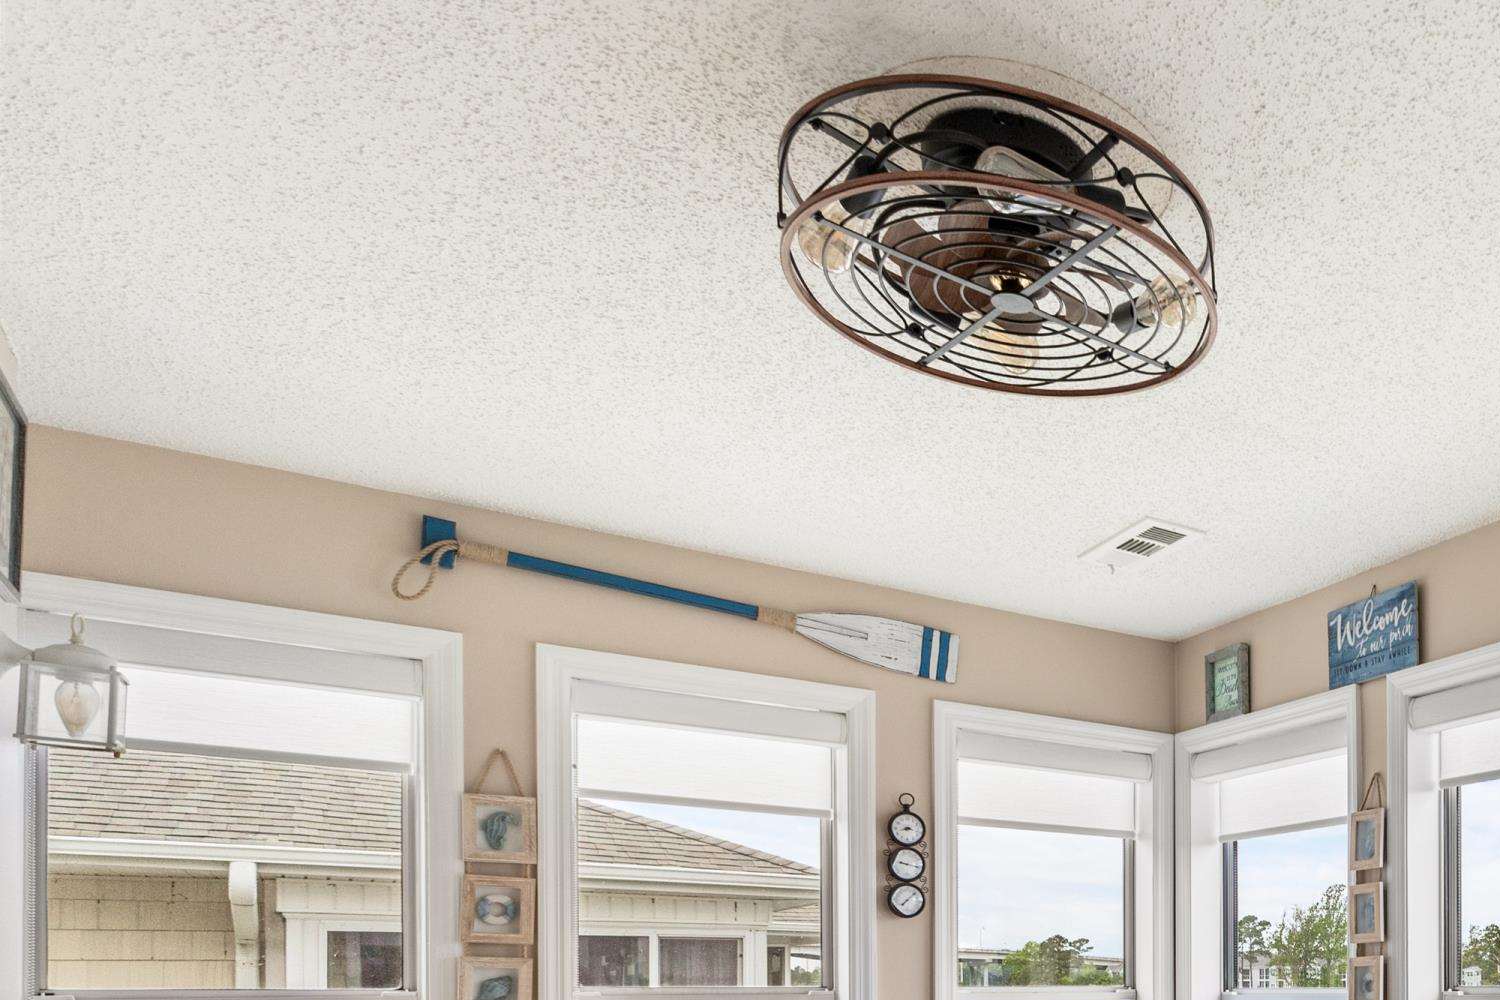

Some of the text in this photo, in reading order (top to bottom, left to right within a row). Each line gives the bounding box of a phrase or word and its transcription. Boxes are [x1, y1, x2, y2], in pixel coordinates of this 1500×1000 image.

[1329, 599, 1413, 652] Welcome
[1345, 662, 1362, 673] DOWN
[1371, 655, 1385, 665] STAY
[1352, 636, 1369, 664] to
[1370, 635, 1386, 652] our
